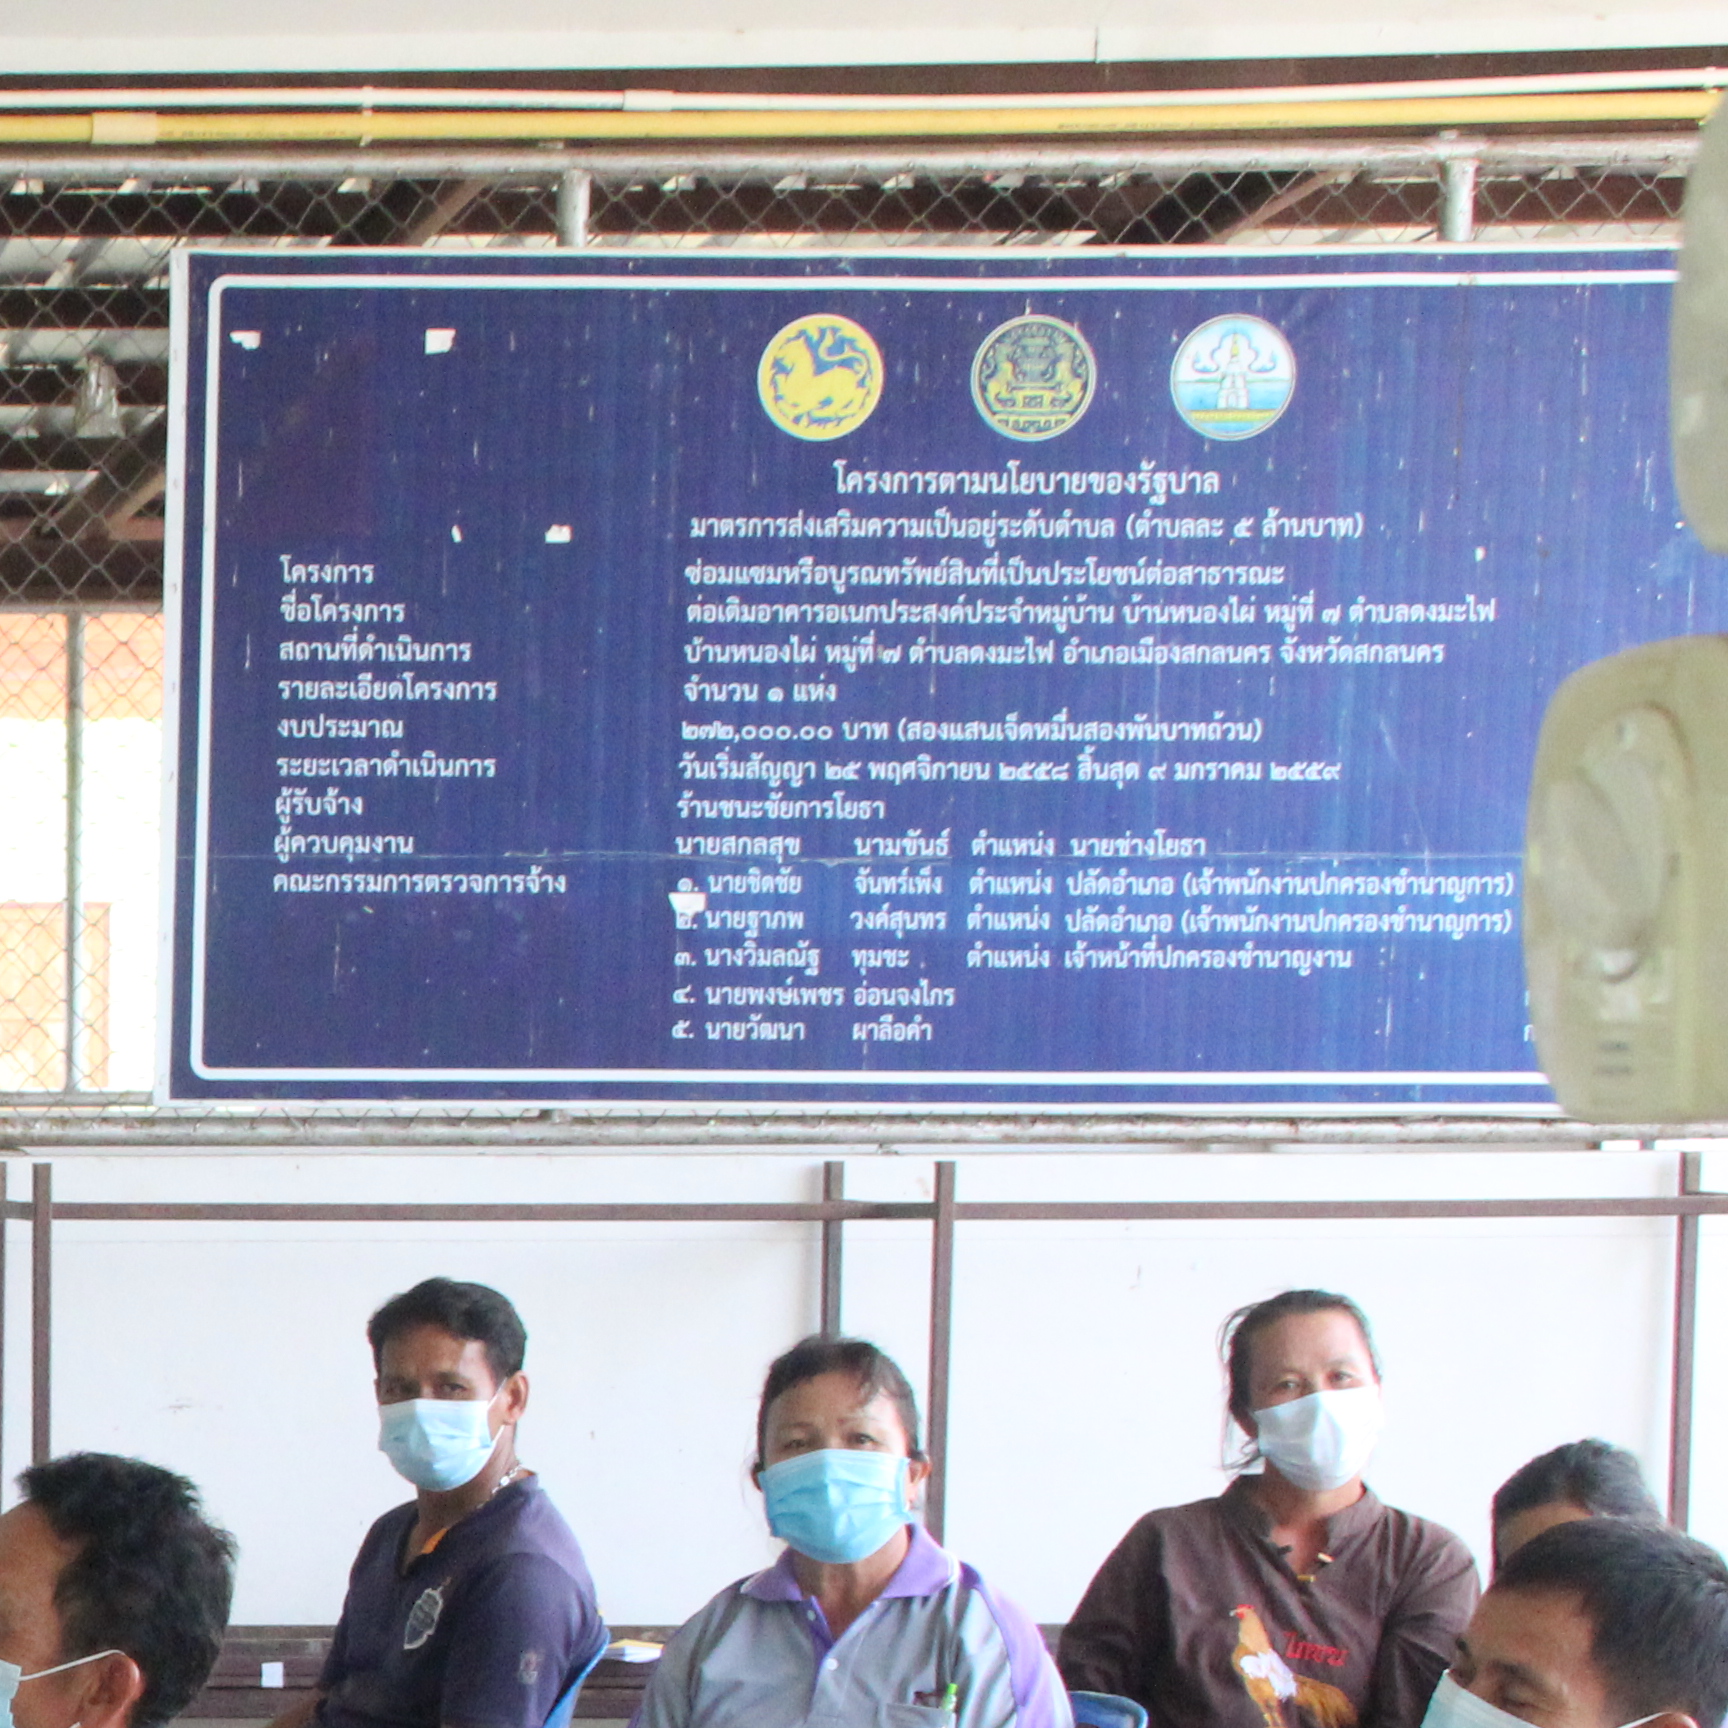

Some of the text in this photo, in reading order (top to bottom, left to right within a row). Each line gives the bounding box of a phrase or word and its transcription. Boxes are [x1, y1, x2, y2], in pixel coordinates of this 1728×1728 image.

[832, 459, 1220, 505] โครงการตามนโยบายของรัฐบาล
[690, 506, 1364, 548] มาตรการส่งเสริมความเป็นอยู่ระดับตำบล (ตำบลละ ๕ ล้านบาท)
[279, 554, 375, 585] โครงการ
[684, 552, 1285, 594] ซ่อมแซมหรือบูรณทรัพย์สินที่เป็นประโยชน์ต่อสาธารณะ
[280, 588, 406, 623] ชื่อโครงการ
[686, 594, 1114, 633] ต่อเติมอาคารอเนกประสงค์ประจำหมู่บ้าน
[1123, 593, 1257, 625] บ้านหนองไผ่
[1264, 589, 1314, 633] หมู่ที่
[1349, 594, 1496, 625] ตำบลดงมะไฟ
[279, 625, 473, 663] สถานที่ดำเนินการ
[684, 634, 817, 665] บ้านหนองไผ่
[825, 629, 876, 673] หมู่ที่
[909, 636, 1054, 665] ตำบลดงมะไฟ
[1063, 636, 1272, 665] อำเภอเมืองสกลนคร
[1280, 635, 1445, 665] จังหวัดสกลนคร
[277, 671, 498, 701] รายละเอียดโครงการ
[683, 672, 838, 703] จำนวน ๑ แห่ง
[277, 713, 405, 739] งบประมาณ
[681, 707, 1264, 745] ๒๗๒,๐๐๐.๐๐ บาท (สองแสนเจ็ดหมื่นสองพันบาทถ้วน)
[276, 748, 497, 778] ระยะเวลาดำเนินการ
[678, 746, 816, 788] วันเริ่มสัญญา
[824, 761, 861, 781] ๒๕
[868, 753, 991, 786] พฤศจิกายน
[999, 761, 1070, 781] ๒๕๕๘
[1078, 745, 1140, 790] สิ้นสุด
[1174, 758, 1261, 782] มกราคม
[1269, 759, 1342, 782] ๒๕๕๙
[275, 786, 363, 824] ผู้รับจ้าง
[676, 790, 885, 820] ร้านชนะชัยการโยธา
[274, 825, 415, 863] ผู้ควบคุมงาน
[675, 827, 1207, 864] นายสกลสุข นามขันธ์ ตำแหน่ง นายช่างโยธา
[273, 865, 567, 894] คณะกรรมการตรวจการจ้าง
[708, 866, 802, 895] นายชิดชัย
[969, 866, 1053, 895] ตำแหน่ง
[1066, 867, 1174, 897] ปลัดอำเภอ
[1183, 866, 1515, 903] (เจ้าพนักงานปกครองชำนาญการ)
[705, 908, 805, 939] นายฐาภพ
[966, 904, 1051, 931] ตำแหน่ง
[1065, 904, 1172, 934] ปลัดอำเภอ
[1181, 903, 1513, 941] (เจ้าพนักงานปกครองชำนาญการ)
[704, 939, 821, 976] นางวิมลณัฐ
[966, 940, 1051, 969] ตำแหน่ง
[1064, 937, 1352, 976] เจ้าหน้าที่ปกครองชำนาญงาน
[704, 976, 845, 1006] นายพงษ์เพชร
[853, 978, 956, 1007] อ่อนจงไกร
[704, 1014, 805, 1042] นายวัฒนา
[852, 1014, 933, 1042] ผาลือคำ
